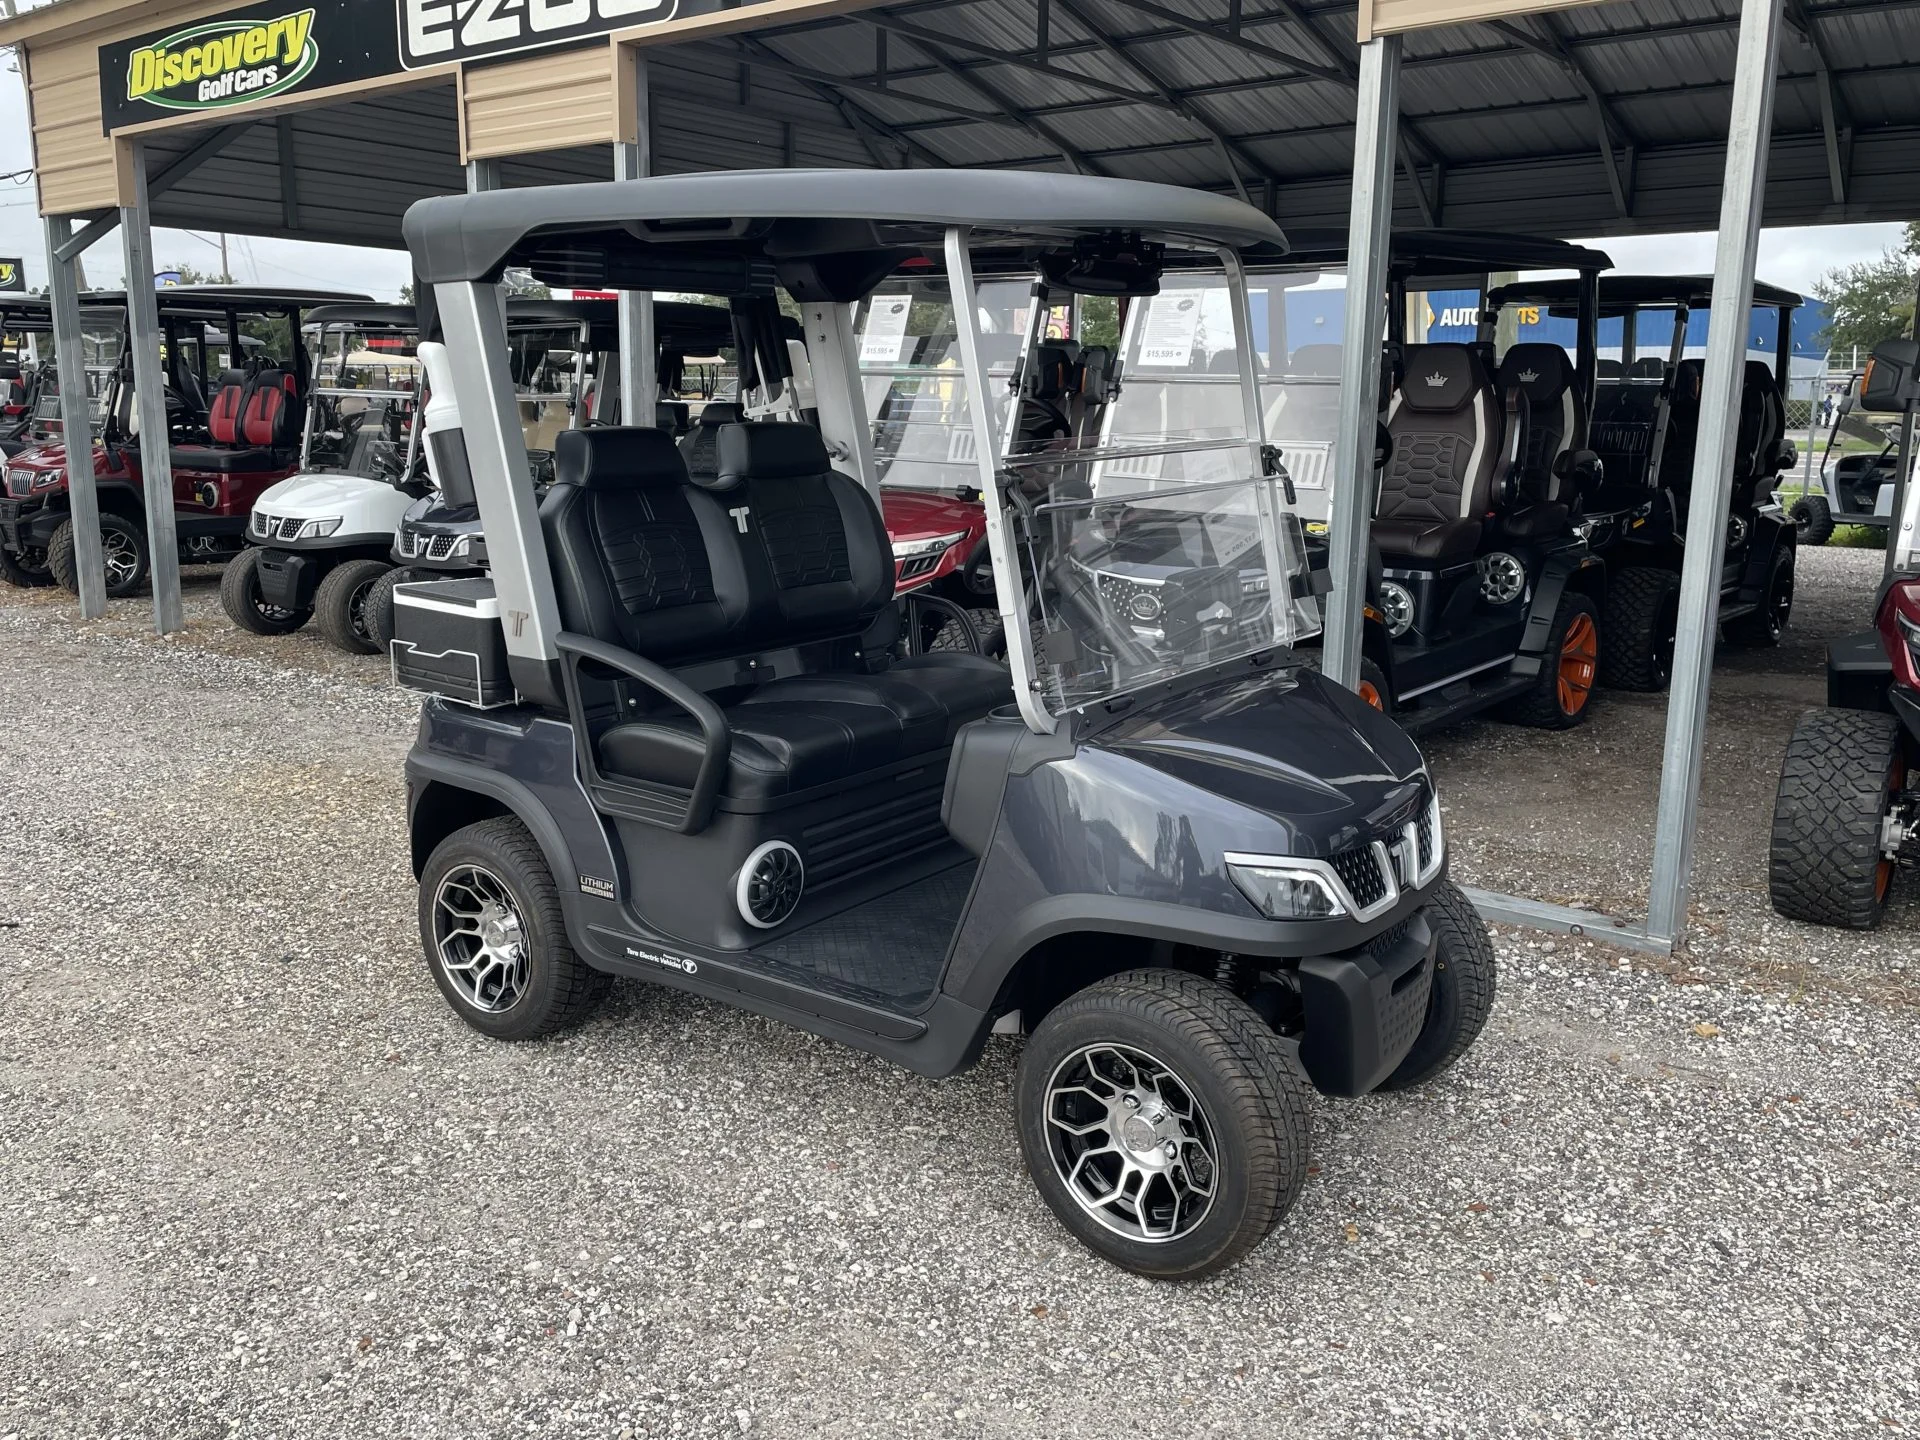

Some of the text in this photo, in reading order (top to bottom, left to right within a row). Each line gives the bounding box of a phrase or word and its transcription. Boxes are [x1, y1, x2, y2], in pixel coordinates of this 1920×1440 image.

[130, 11, 312, 98] Discovery
[199, 65, 278, 102] Golf Cars
[580, 876, 614, 891] LITHIUM
[640, 950, 660, 963] Electric
[660, 957, 682, 970] Vehicles
